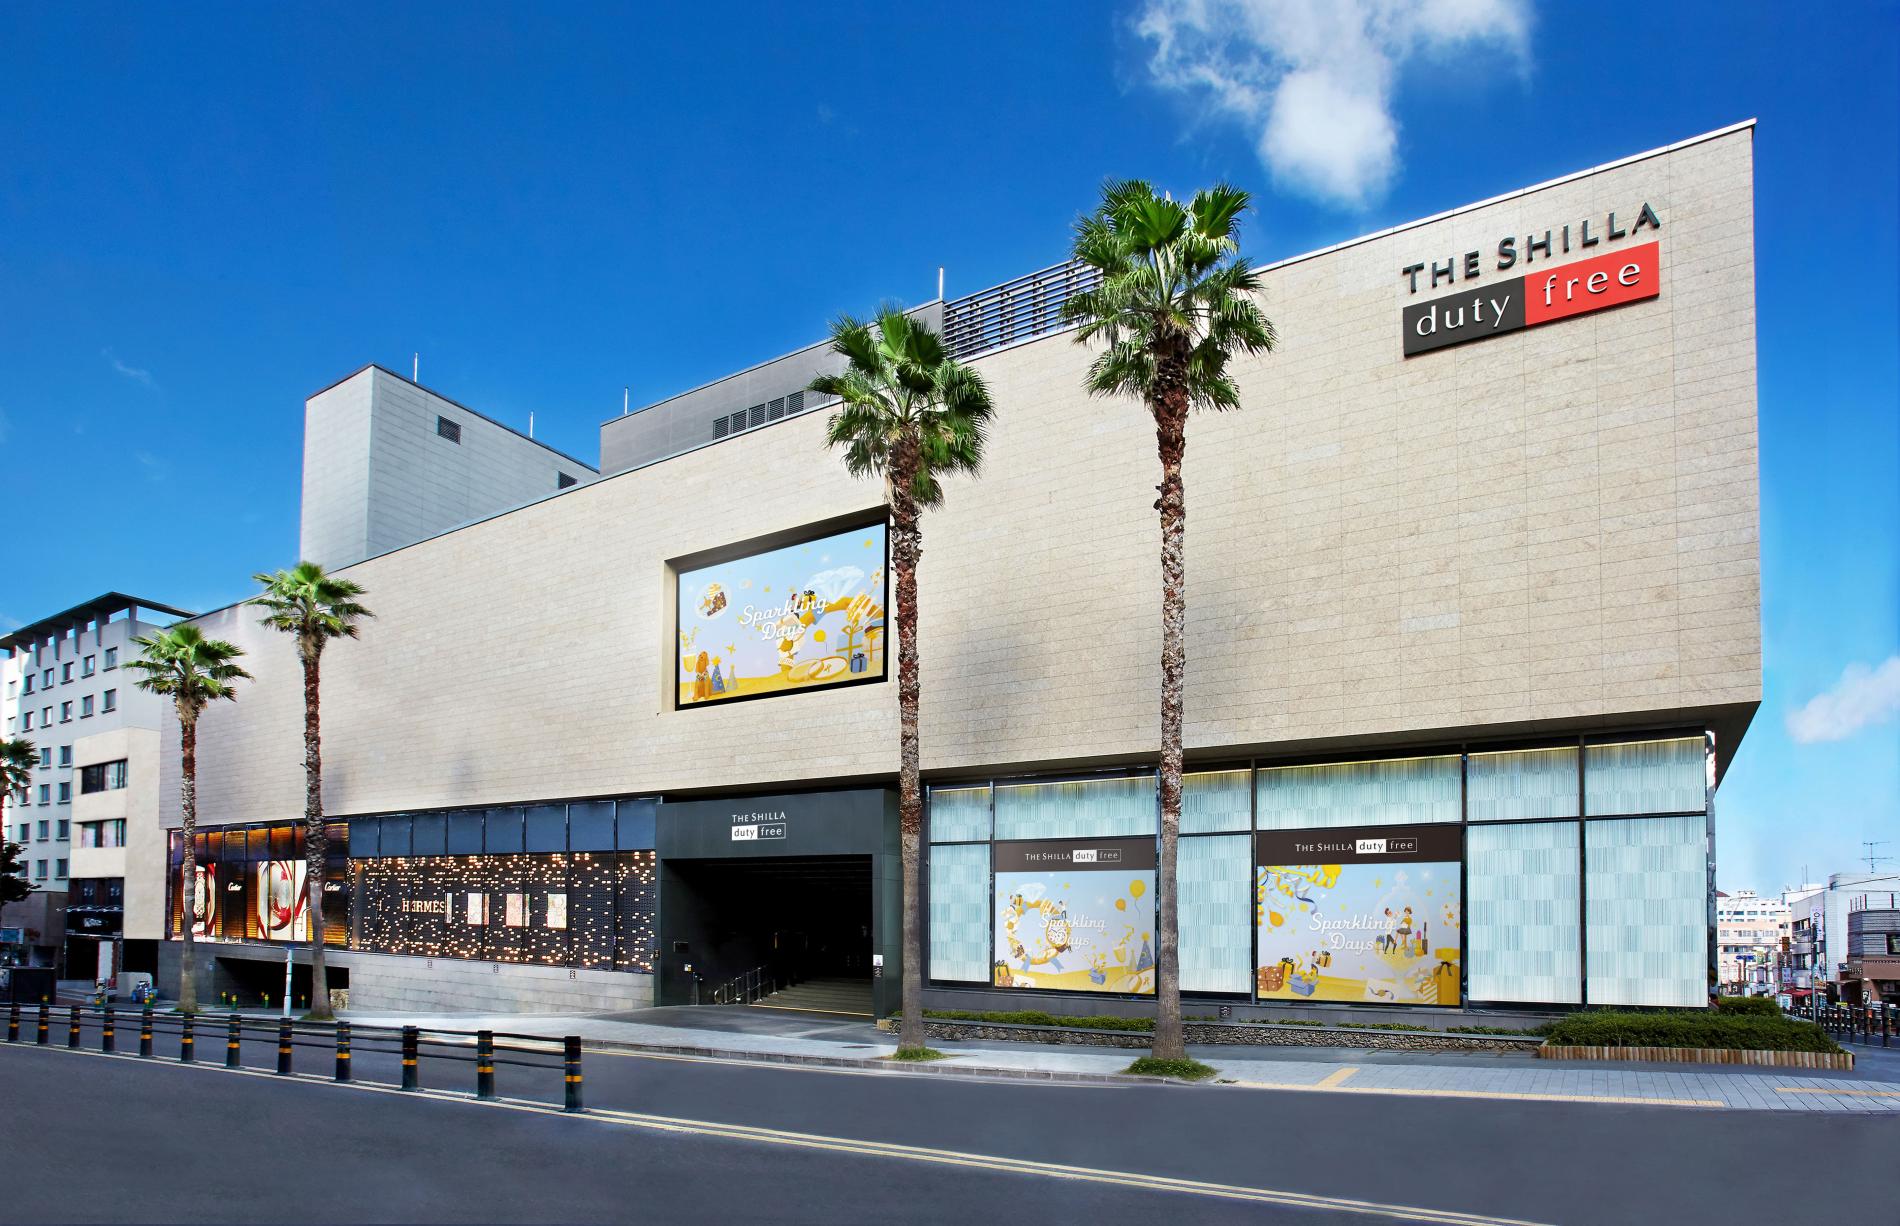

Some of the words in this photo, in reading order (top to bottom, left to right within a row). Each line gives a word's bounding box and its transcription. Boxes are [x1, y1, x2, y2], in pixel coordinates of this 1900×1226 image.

[1402, 250, 1480, 293] THE
[1497, 202, 1661, 270] SHILLA
[1415, 295, 1510, 336] duty
[1542, 262, 1641, 306] free
[740, 597, 829, 627] Sparkling
[762, 621, 806, 641] Days
[731, 814, 749, 823] THE
[751, 811, 786, 822] SHILLA
[734, 828, 755, 839] duty
[760, 826, 782, 836] free
[1025, 853, 1040, 861] THE
[1042, 852, 1071, 861] SHILLA
[1075, 851, 1095, 862] duty
[1099, 850, 1118, 860] free
[1295, 843, 1314, 852] THE
[1317, 842, 1354, 852] SHILLA
[1359, 841, 1384, 852] duty
[1390, 840, 1413, 850] free
[1309, 912, 1397, 935] Sparkling
[1330, 932, 1375, 956] Days
